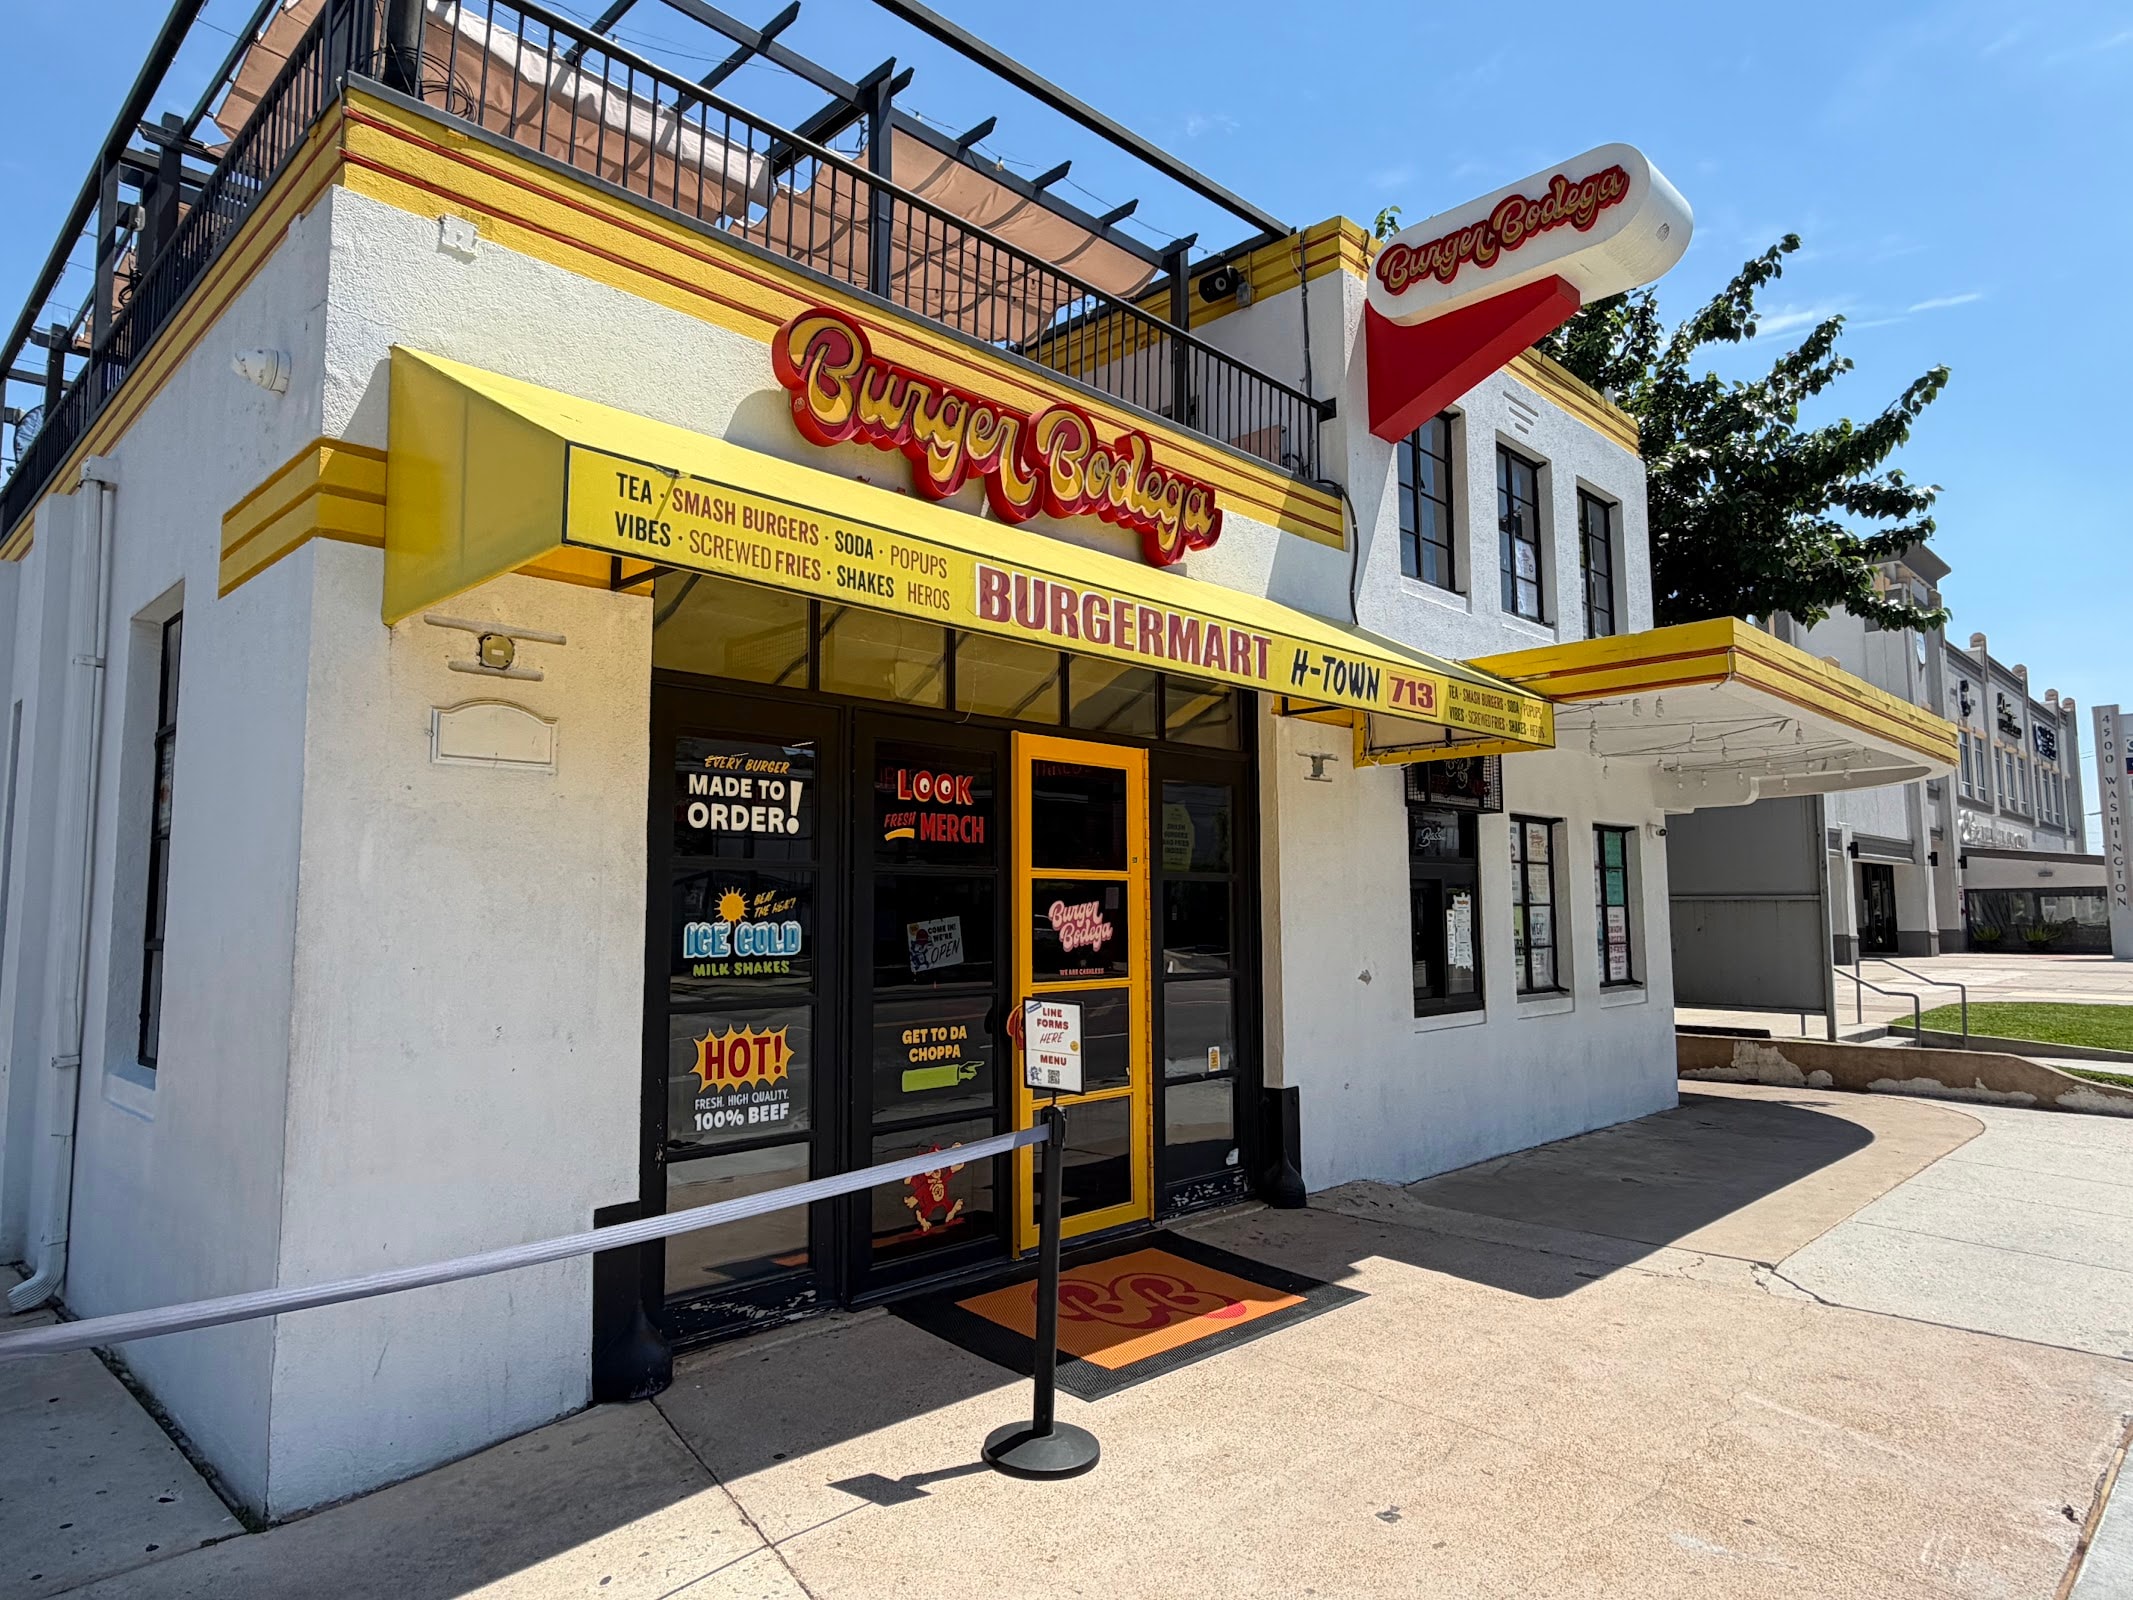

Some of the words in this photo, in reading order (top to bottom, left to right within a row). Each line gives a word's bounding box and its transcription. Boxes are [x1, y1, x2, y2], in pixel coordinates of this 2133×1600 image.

[1377, 223, 1499, 295] Burger
[1489, 165, 1630, 250] Bodega
[774, 308, 1042, 522] Burger
[1030, 402, 1222, 566] Bodega
[616, 472, 652, 504] TEA
[672, 488, 735, 526] SMASH
[742, 506, 819, 546] BURGERS
[835, 531, 874, 560] SODA
[890, 544, 947, 579] POPUPS
[615, 511, 671, 547] VIBES
[689, 530, 772, 570] SCREWED
[775, 551, 821, 581] FRIES
[837, 565, 894, 598] SHAKES
[907, 582, 950, 611] HEROS
[975, 563, 1272, 680] BURGERMART
[1291, 648, 1380, 702] H-TOWN
[1389, 676, 1433, 709] 713
[1448, 685, 1458, 700] TEA
[1463, 688, 1480, 704] SMASH
[1507, 700, 1519, 714] SODA
[1448, 706, 1464, 722] VIBES
[2102, 714, 2114, 764] 4500
[705, 755, 742, 770] EVERY
[745, 759, 790, 774] BURGER
[688, 774, 752, 798] MADE
[758, 779, 785, 800] TO
[898, 769, 974, 806] LOOK
[687, 780, 803, 834] ORDER!
[884, 811, 916, 828] FRESH
[920, 812, 984, 843] MERCH
[2105, 776, 2127, 907] WASHINGTON
[928, 925, 946, 934] COME
[1048, 900, 1104, 931] Burger
[683, 922, 731, 958] ICE
[734, 920, 801, 957] COLD
[931, 938, 960, 964] OPEN
[1059, 919, 1113, 952] Bodega
[693, 963, 729, 977] MILK
[734, 960, 790, 975] SHAKES
[1037, 1019, 1069, 1030] FORMS
[1042, 1008, 1063, 1018] LINE
[902, 1028, 929, 1045] GET
[930, 1027, 948, 1042] TO
[950, 1025, 968, 1040] DA
[1040, 1032, 1065, 1044] HERE
[705, 1035, 782, 1080] HOT!
[909, 1044, 961, 1063] CHOPPA
[1040, 1054, 1067, 1067] MENU
[728, 1093, 749, 1107] HIGH
[752, 1089, 789, 1103] QUALITY.
[694, 1109, 745, 1131] 100%
[748, 1102, 790, 1124] BEEF
